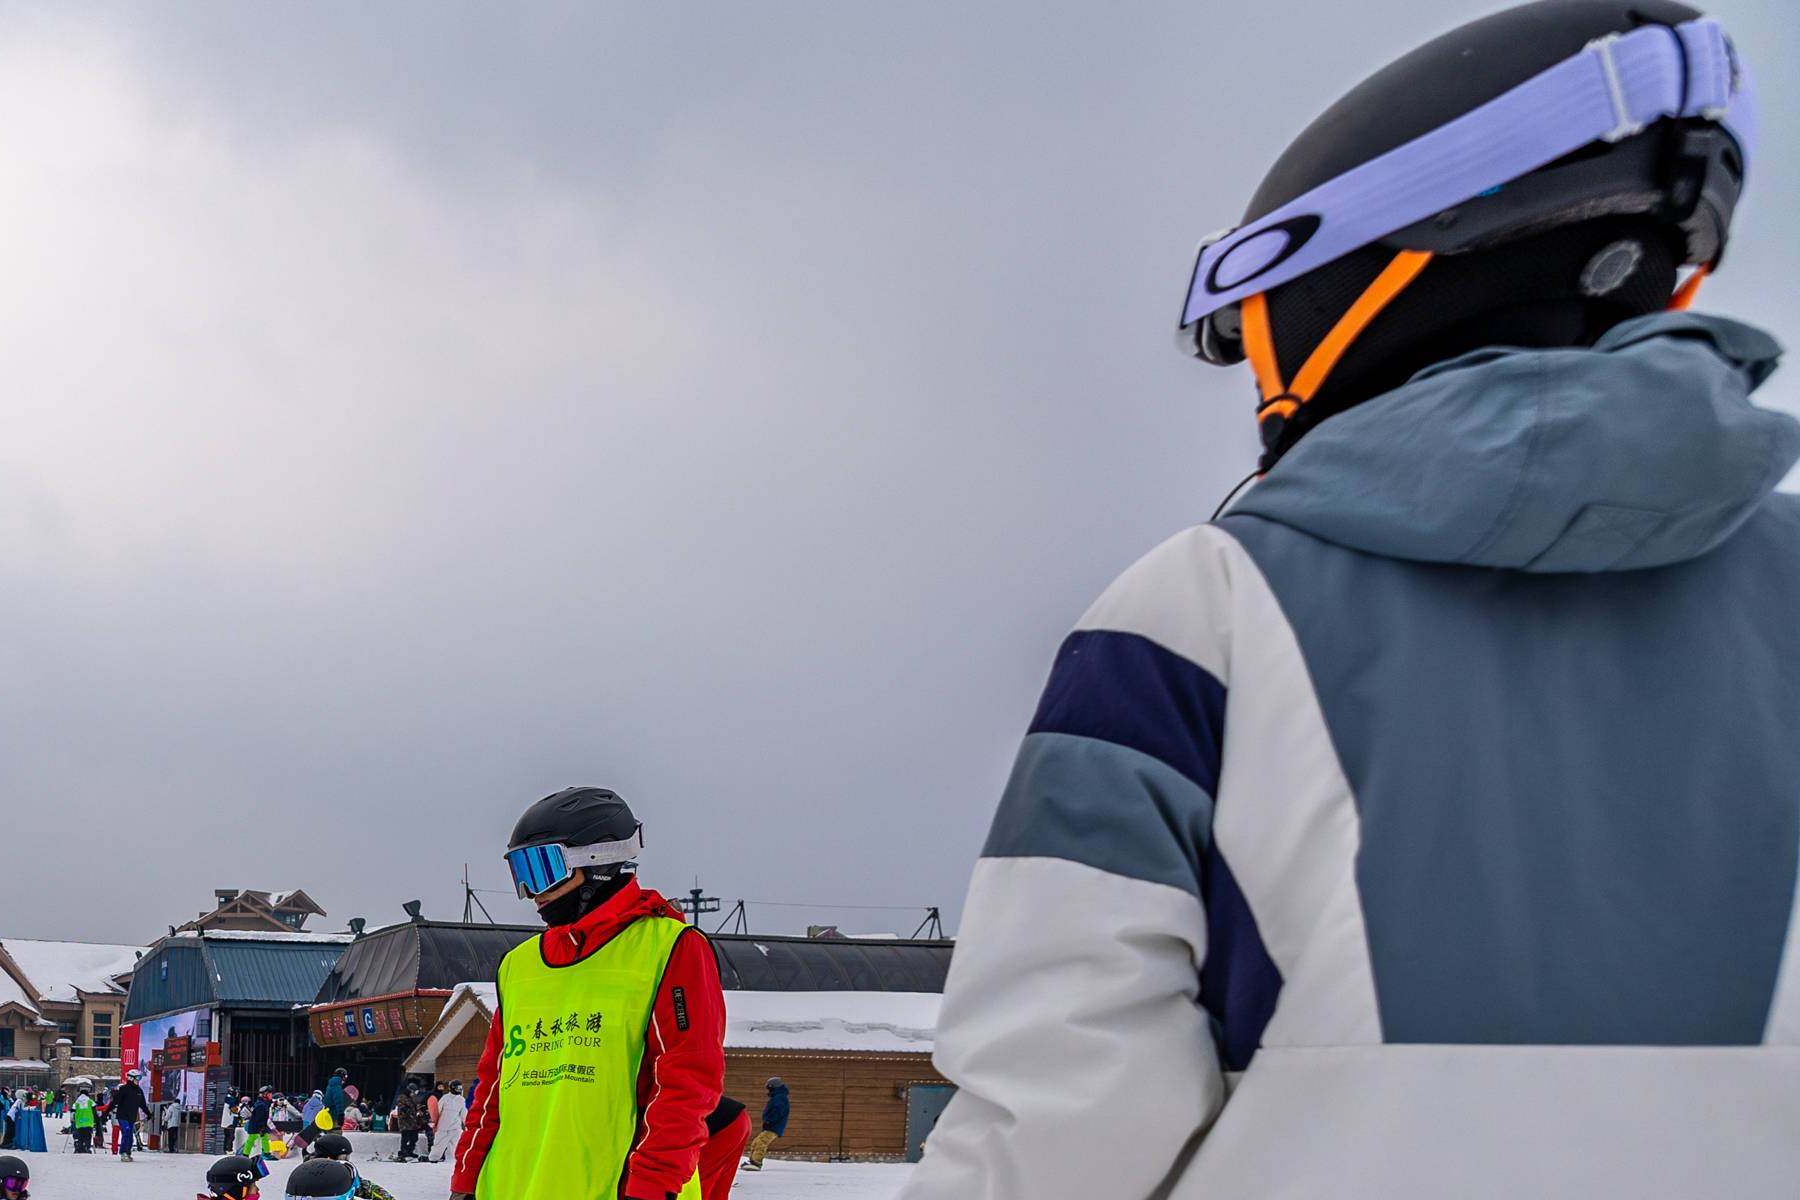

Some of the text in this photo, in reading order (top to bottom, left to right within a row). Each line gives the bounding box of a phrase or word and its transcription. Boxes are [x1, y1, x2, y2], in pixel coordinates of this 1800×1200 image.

[532, 1012, 602, 1040] 春秋旅游
[568, 1035, 601, 1048] TOUR
